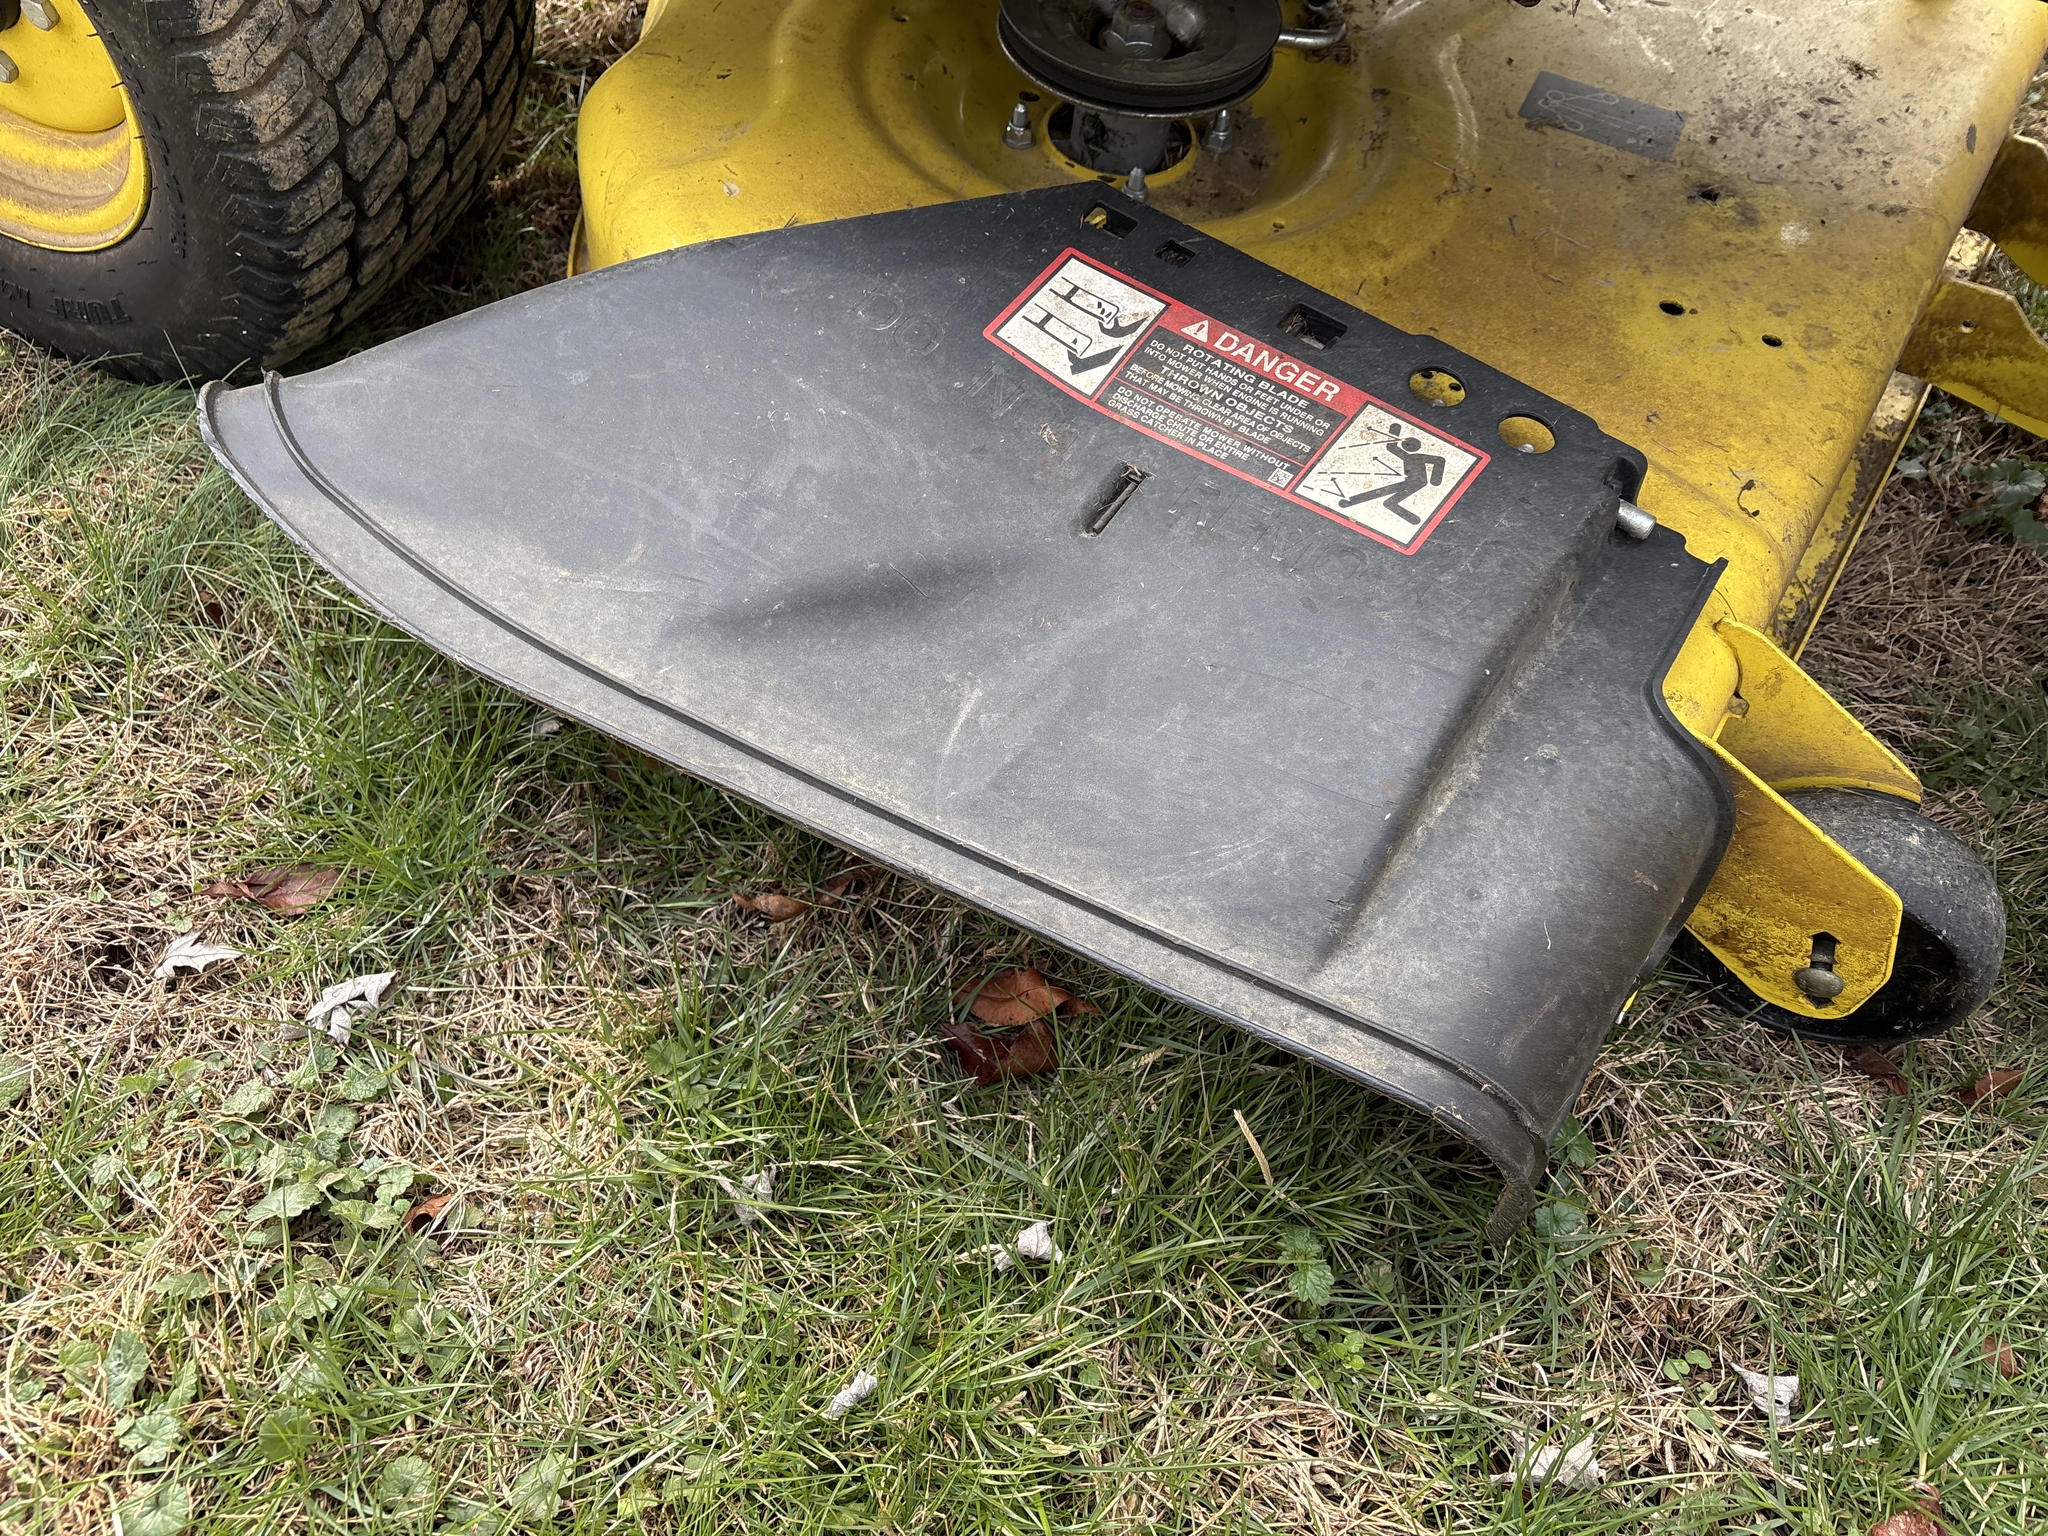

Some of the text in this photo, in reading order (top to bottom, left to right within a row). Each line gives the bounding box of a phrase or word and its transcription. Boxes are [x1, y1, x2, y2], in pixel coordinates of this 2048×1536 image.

[46, 296, 133, 325] TURF
[850, 287, 945, 355] DO
[1144, 347, 1324, 436] INTO MOWER WHEN ENGINE IS RUNNING
[1150, 340, 1330, 430] DO NOT PUT HANDS OR FEET UNDER OR
[1160, 365, 1294, 433] THROWN OBJECTS
[1182, 344, 1310, 408] ROTATING BLADE
[1213, 331, 1340, 402] DANGER
[1108, 399, 1229, 460] GRASS CATCHER IN PLACE
[1112, 393, 1250, 460] DISCHARGE CHUTE OR ENTIRE
[1117, 386, 1290, 469] DO NOT OPERATE MOWER WITHOUT
[1125, 371, 1271, 444] THAT MAY BE THROWN BY BLADE
[1130, 364, 1165, 384] BEFORE
[1202, 398, 1232, 416] CLEAR
[1231, 411, 1255, 427] AREA
[1256, 424, 1270, 433] OF
[1269, 430, 1311, 452] OBJECTS
